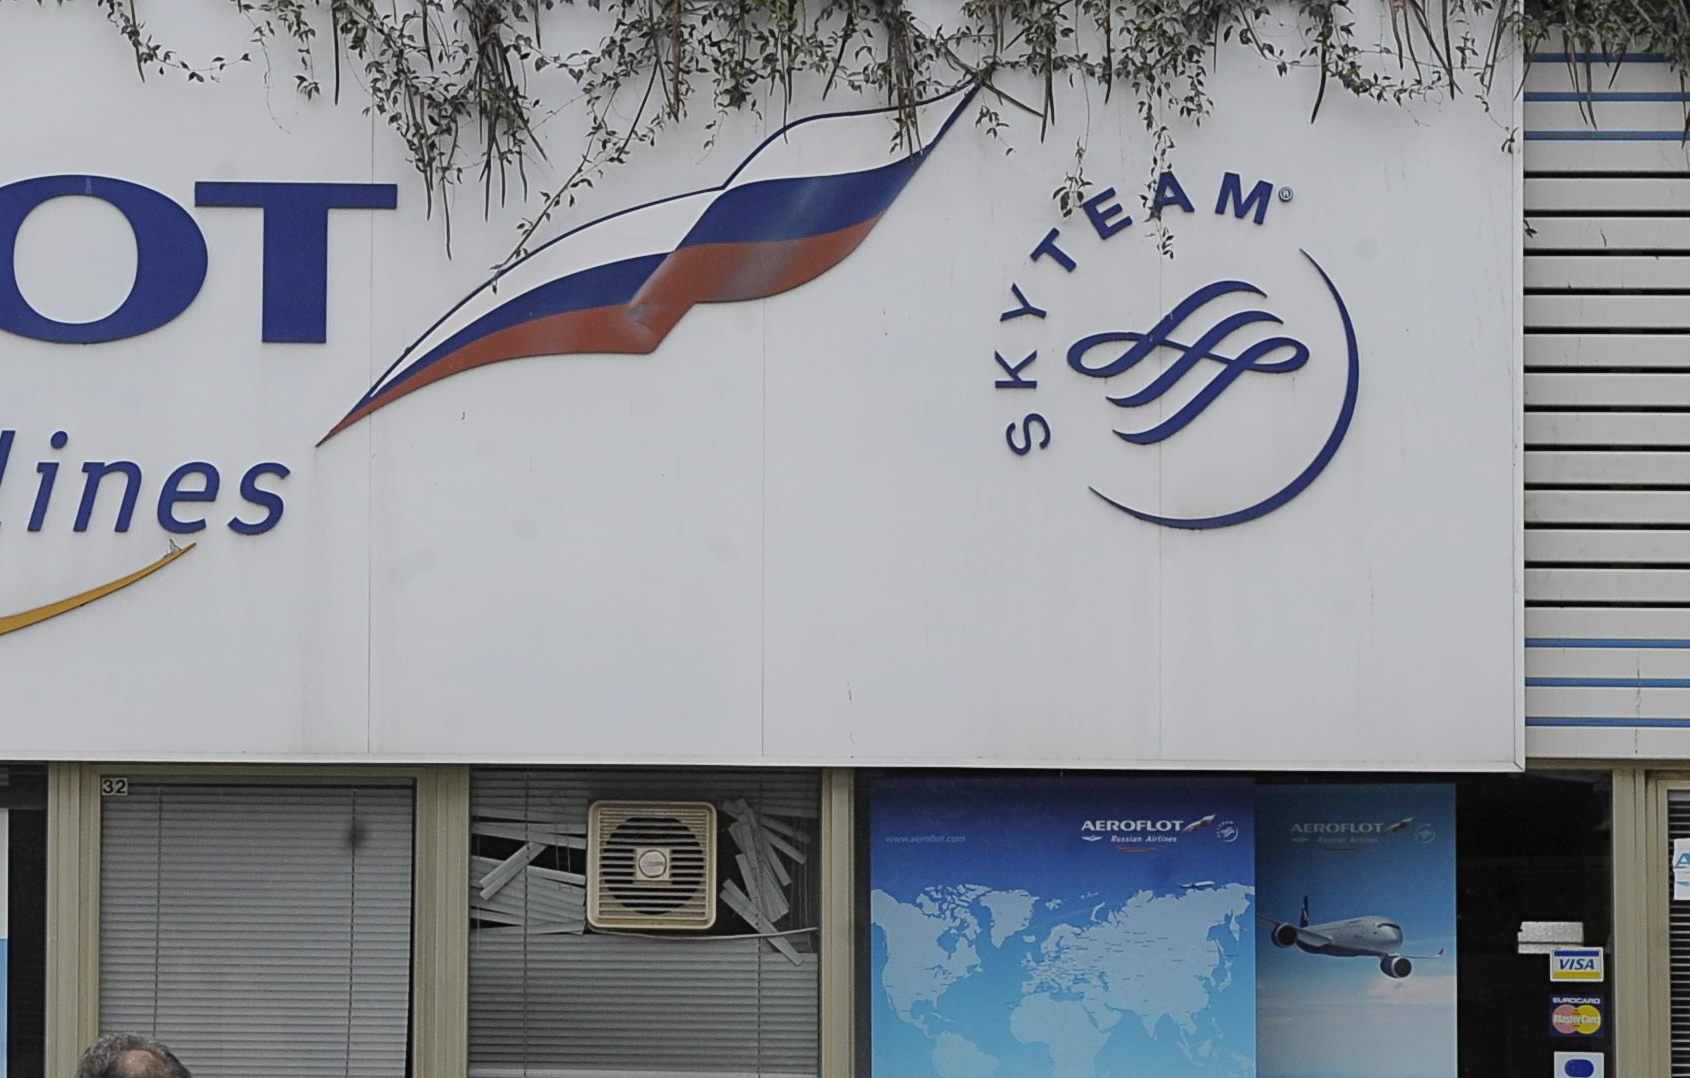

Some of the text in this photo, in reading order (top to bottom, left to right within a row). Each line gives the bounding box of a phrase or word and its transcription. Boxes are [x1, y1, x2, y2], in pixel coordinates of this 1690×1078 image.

[994, 169, 1274, 456] SKYTEAM
[102, 779, 127, 794] 32
[1080, 819, 1184, 832] AEROFLOT
[1290, 822, 1385, 833] AEROFLOT
[1110, 834, 1178, 844] Russian Airlines
[1559, 958, 1595, 971] VISA
[1553, 1014, 1602, 1025] MasterCard
